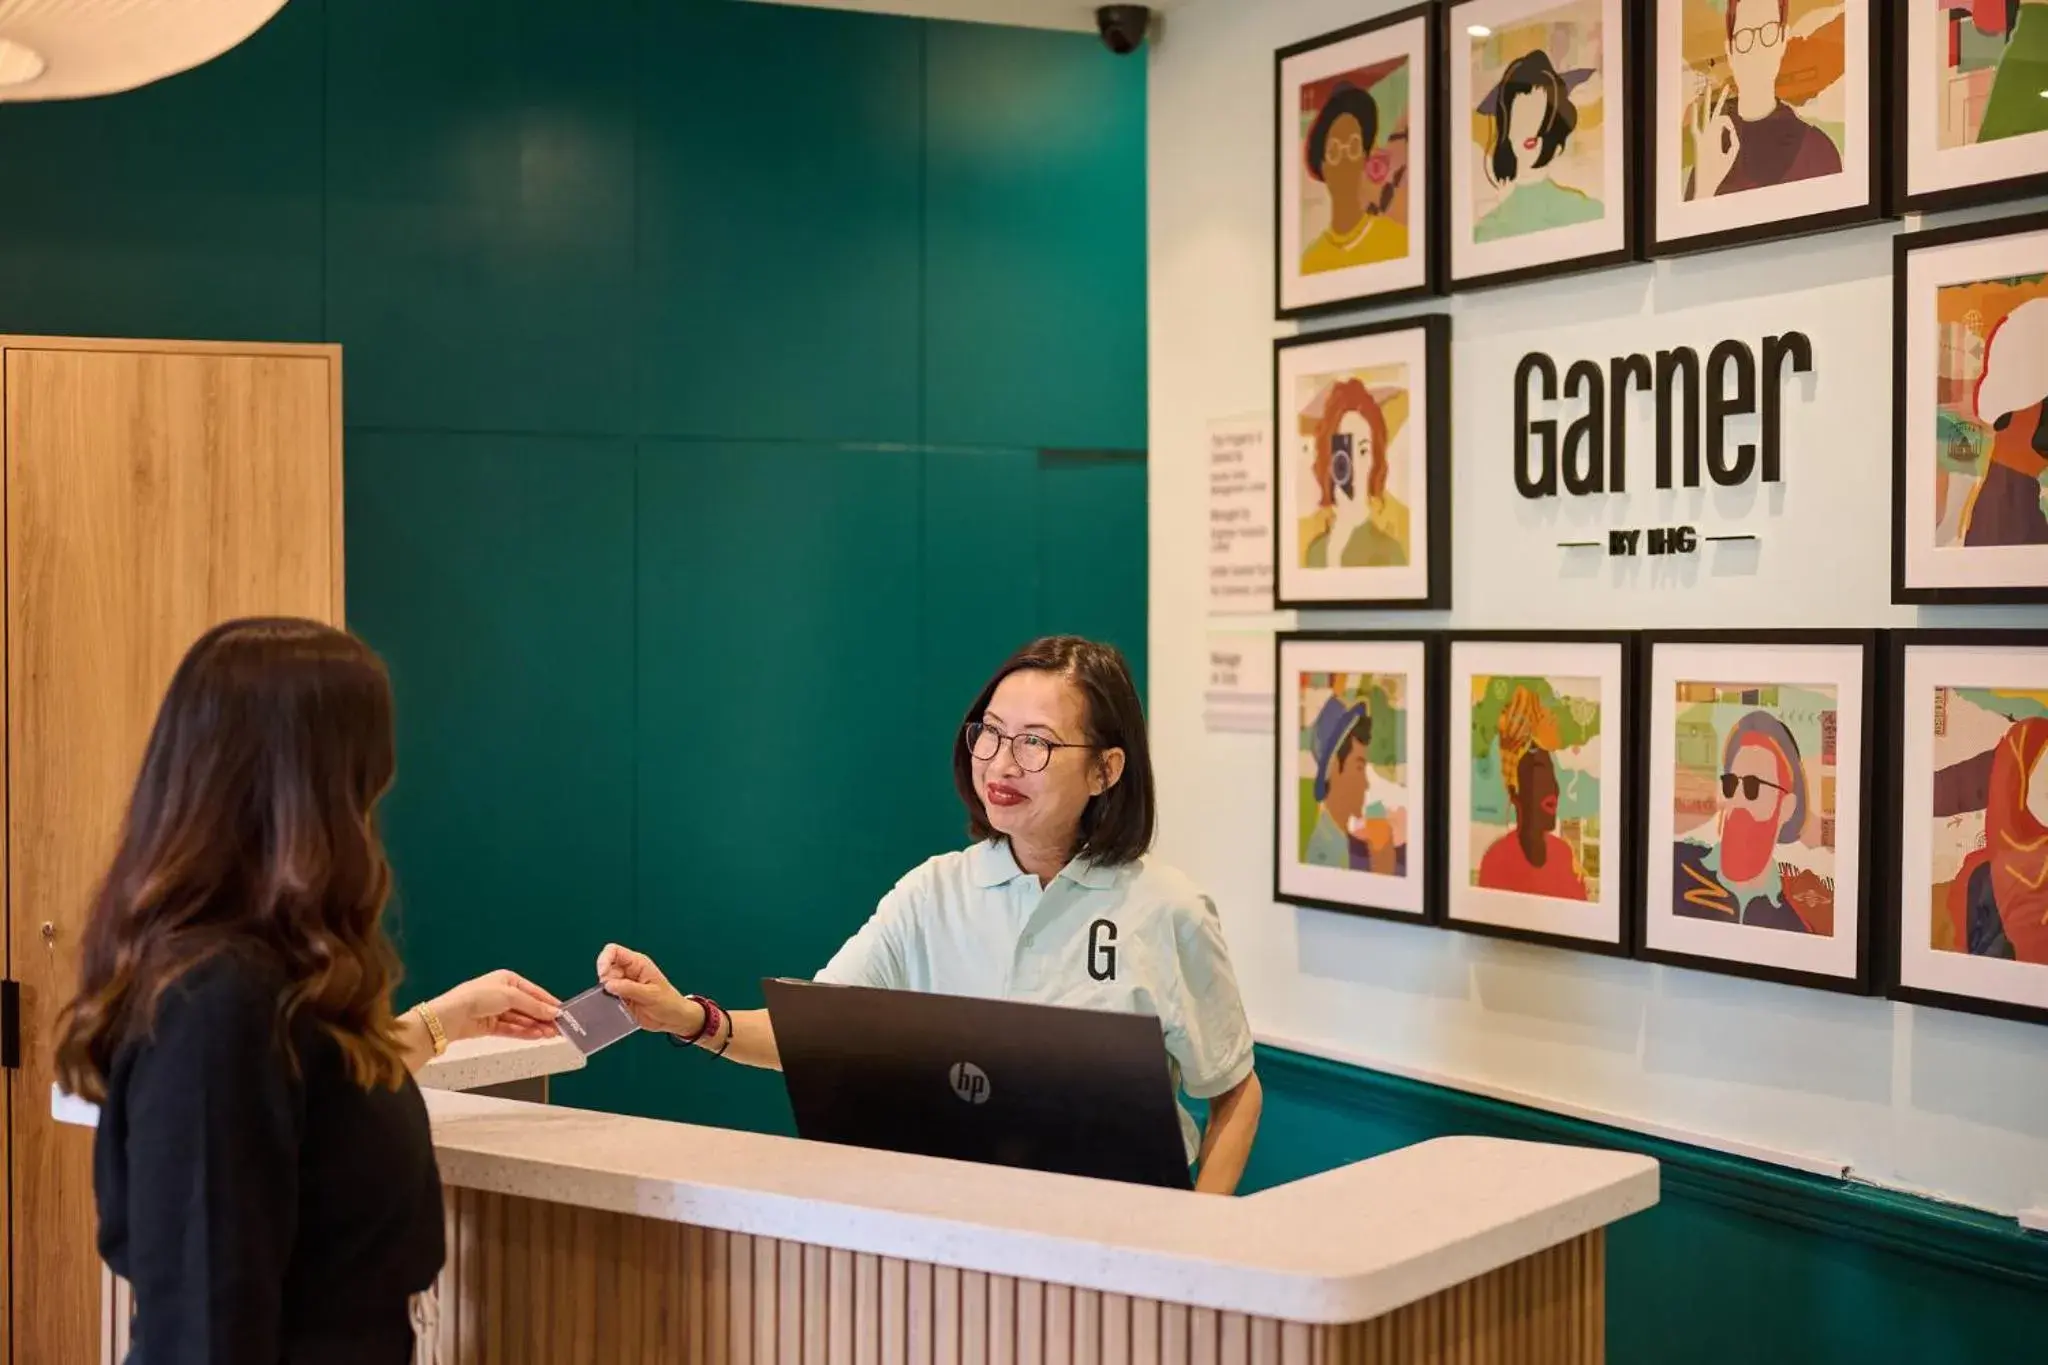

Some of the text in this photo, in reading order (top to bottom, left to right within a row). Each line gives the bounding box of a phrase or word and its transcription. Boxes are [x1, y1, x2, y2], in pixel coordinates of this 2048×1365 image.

[1514, 331, 1813, 499] Garner
[1609, 526, 1697, 556] BY IHG
[1088, 918, 1118, 981] G
[954, 1062, 987, 1103] hp
